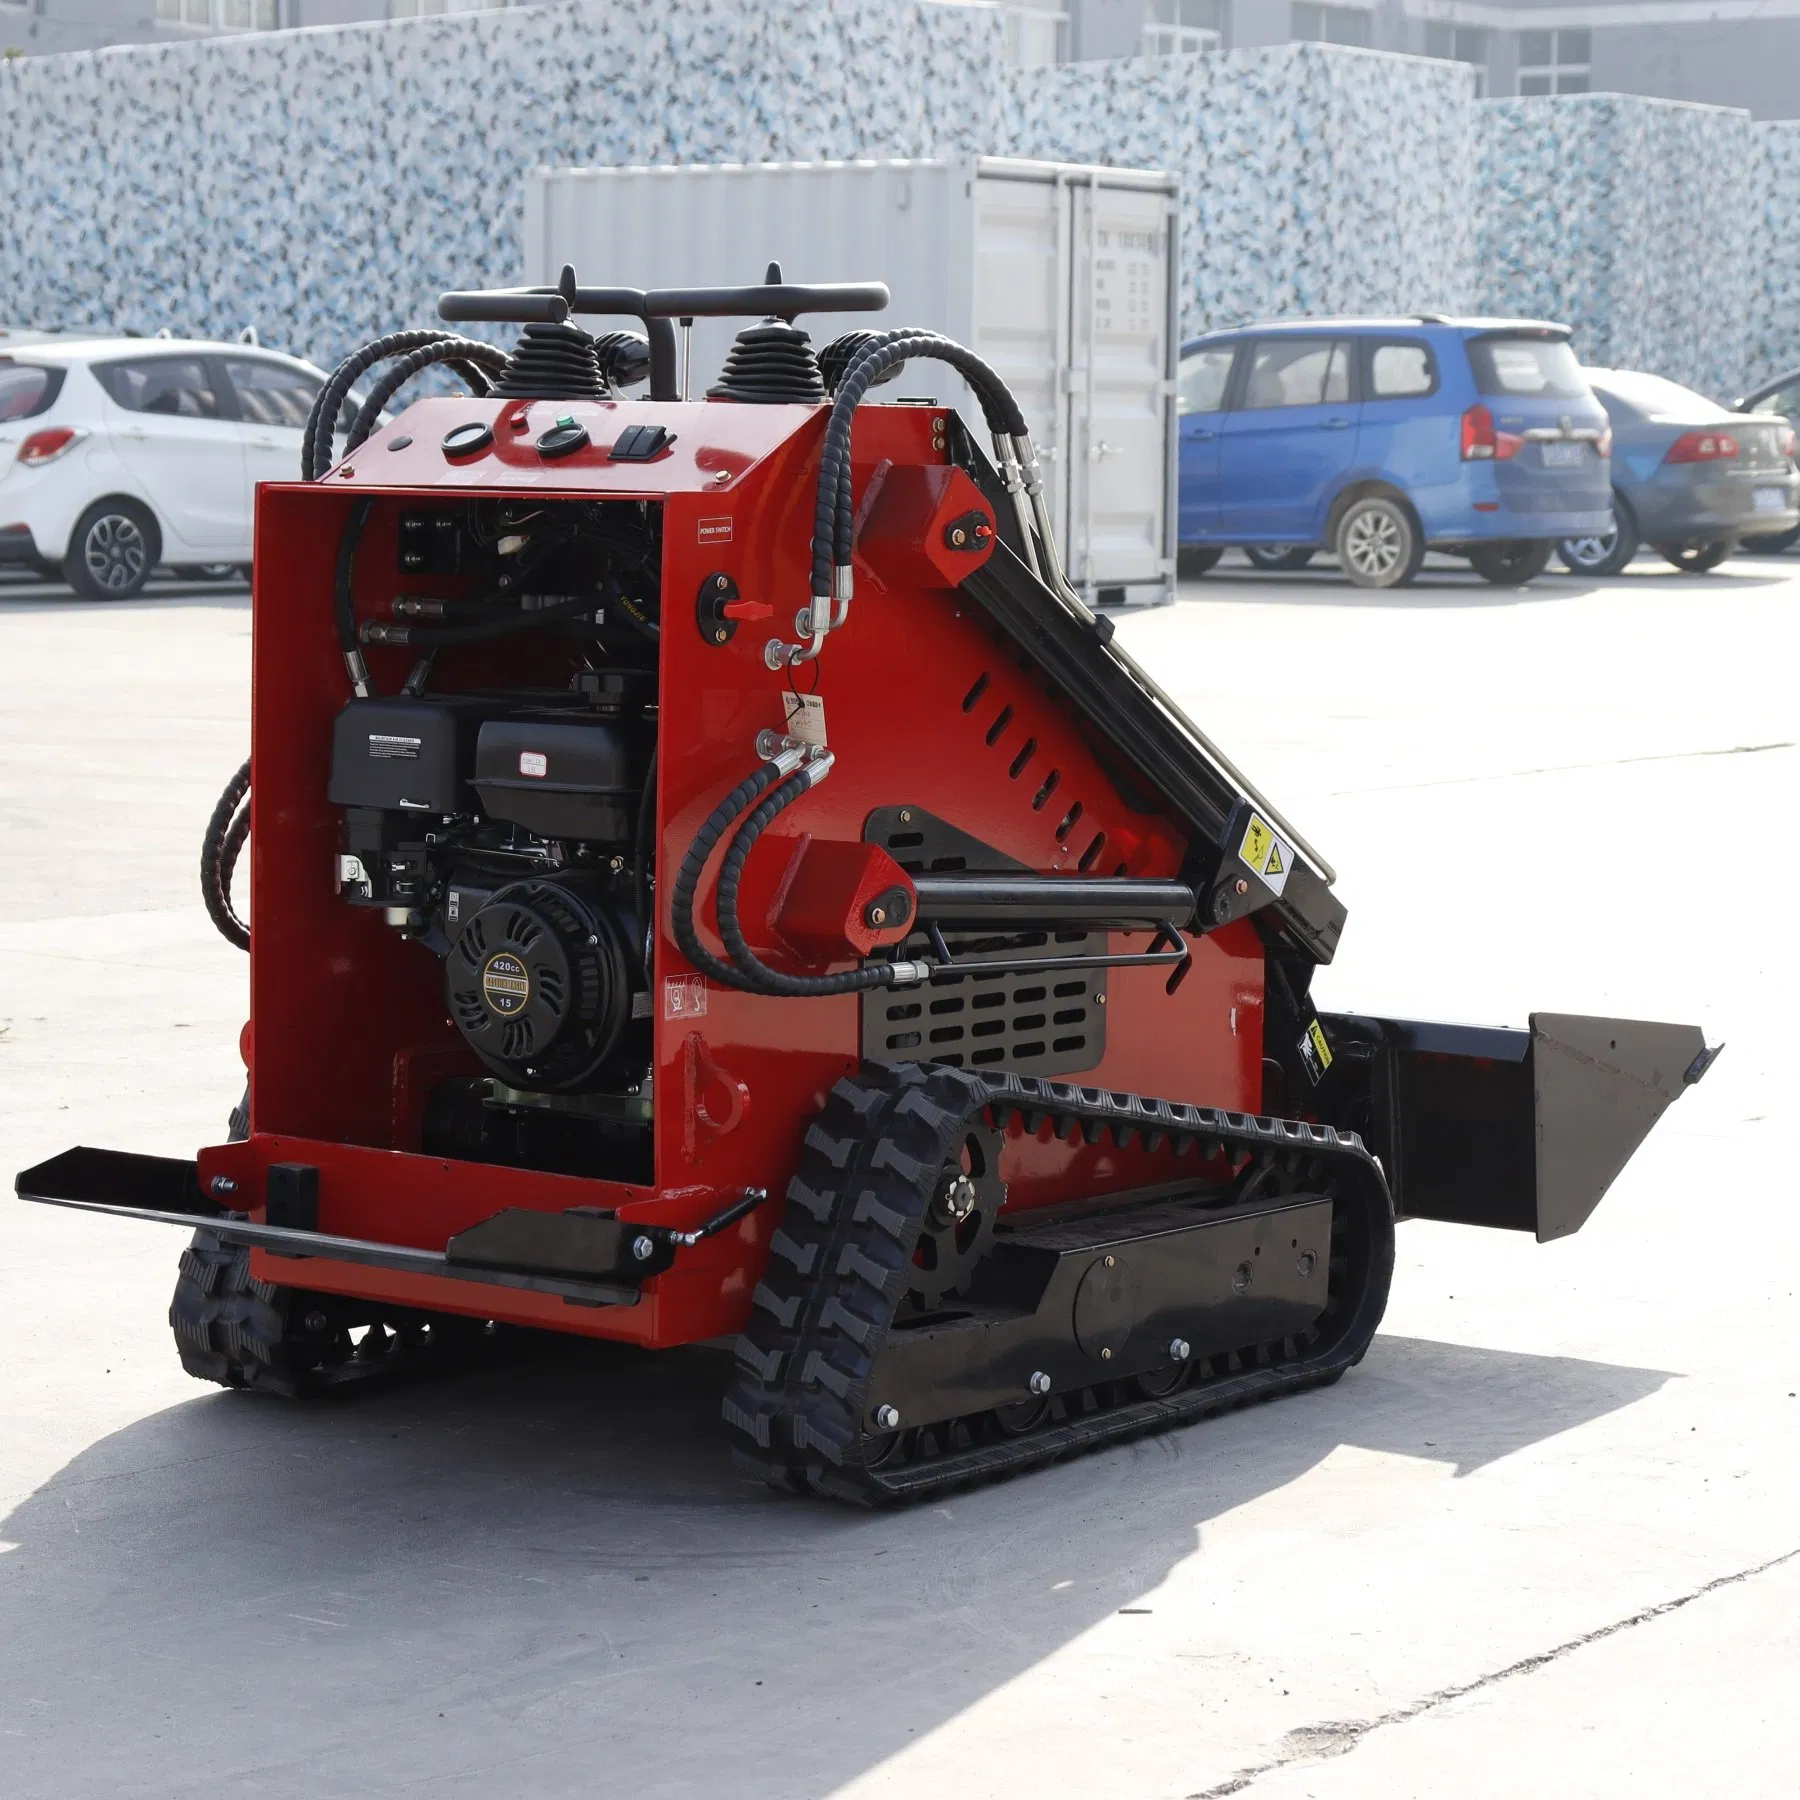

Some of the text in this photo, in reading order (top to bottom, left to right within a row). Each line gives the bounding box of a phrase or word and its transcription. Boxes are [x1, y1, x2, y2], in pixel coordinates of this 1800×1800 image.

[715, 526, 731, 534] SWITCH
[493, 960, 521, 973] 420cc
[500, 998, 511, 1008] 15
[1316, 1035, 1330, 1065] CAUTION
